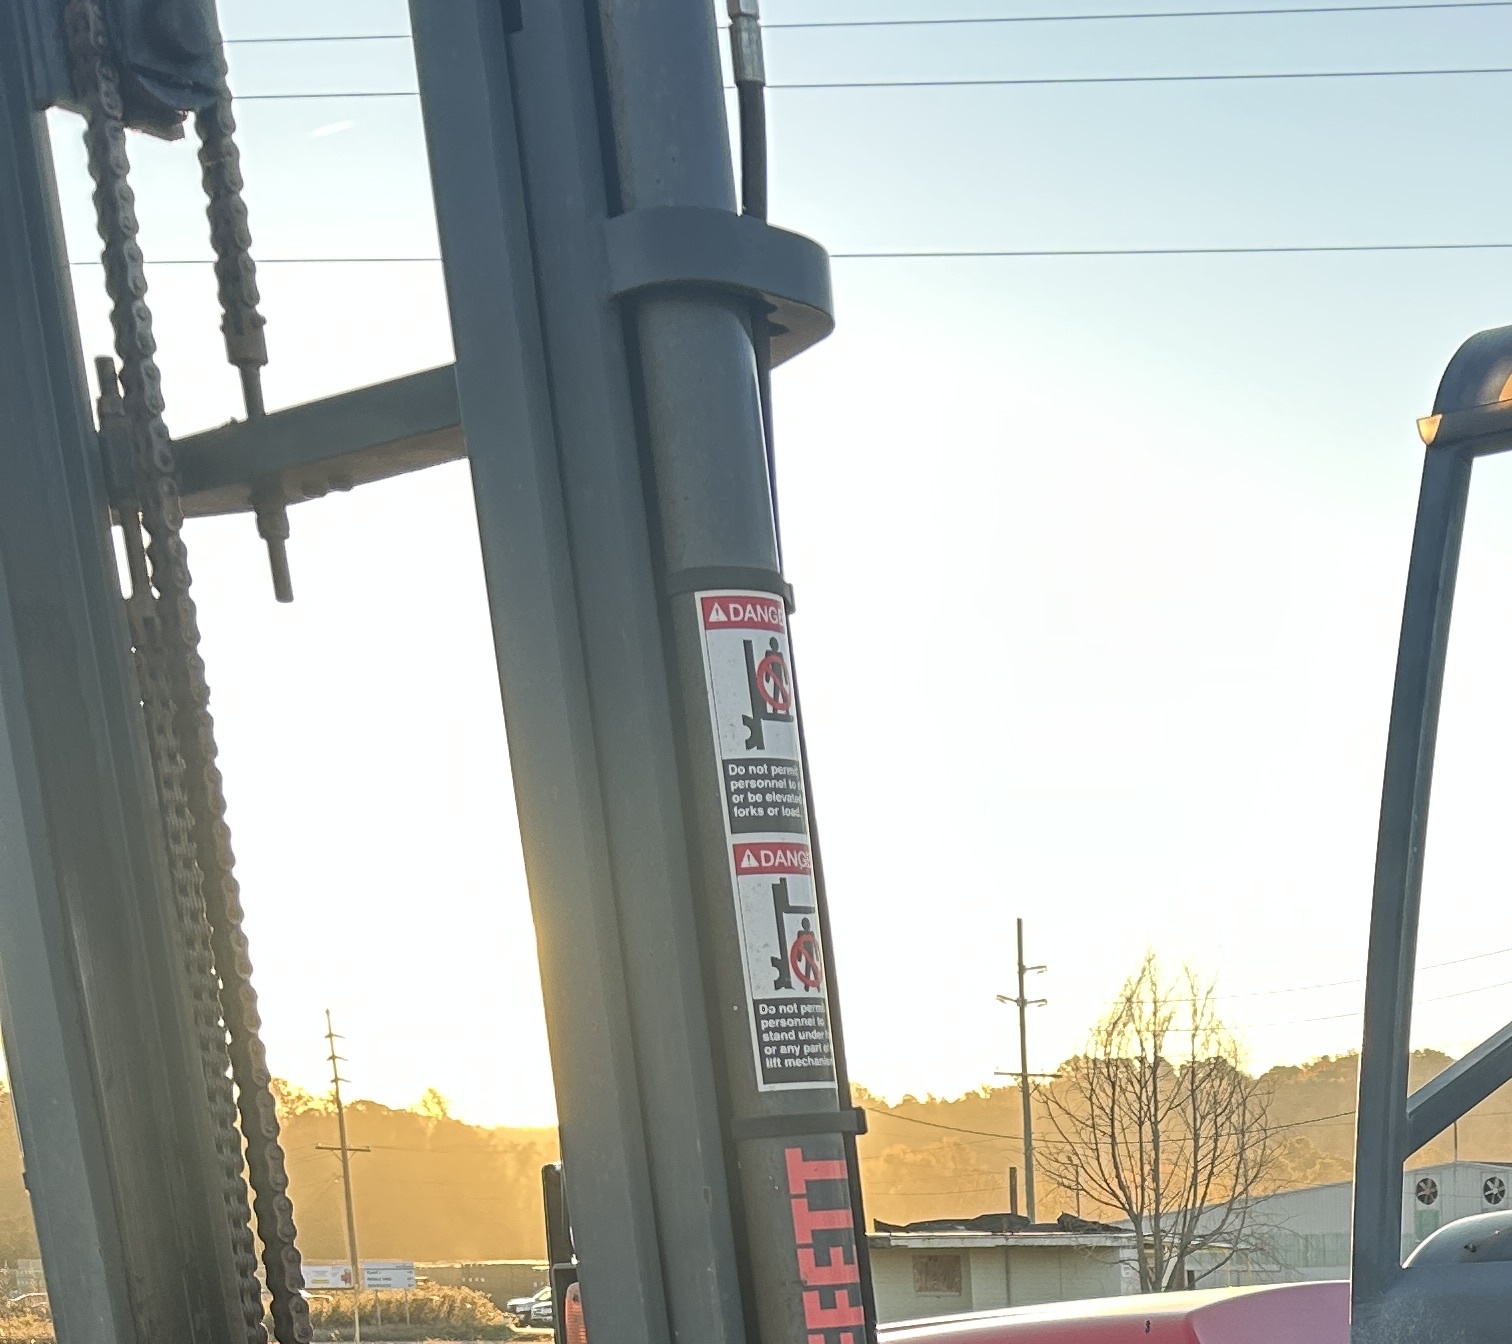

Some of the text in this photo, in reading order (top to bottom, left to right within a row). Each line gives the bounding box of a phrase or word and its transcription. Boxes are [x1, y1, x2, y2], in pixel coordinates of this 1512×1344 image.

[728, 764, 746, 776] Do
[748, 763, 769, 775] not
[730, 778, 787, 793] personnel
[732, 794, 745, 804] or
[747, 791, 763, 803] be
[733, 804, 765, 818] forks
[767, 806, 780, 816] or
[759, 1004, 776, 1015] Do
[779, 1003, 798, 1014] not
[761, 1015, 816, 1030] personnel
[763, 1030, 795, 1042] stand
[798, 1029, 825, 1041] under
[764, 1046, 777, 1056] or
[779, 1043, 801, 1057] any
[766, 1057, 782, 1068] lift
